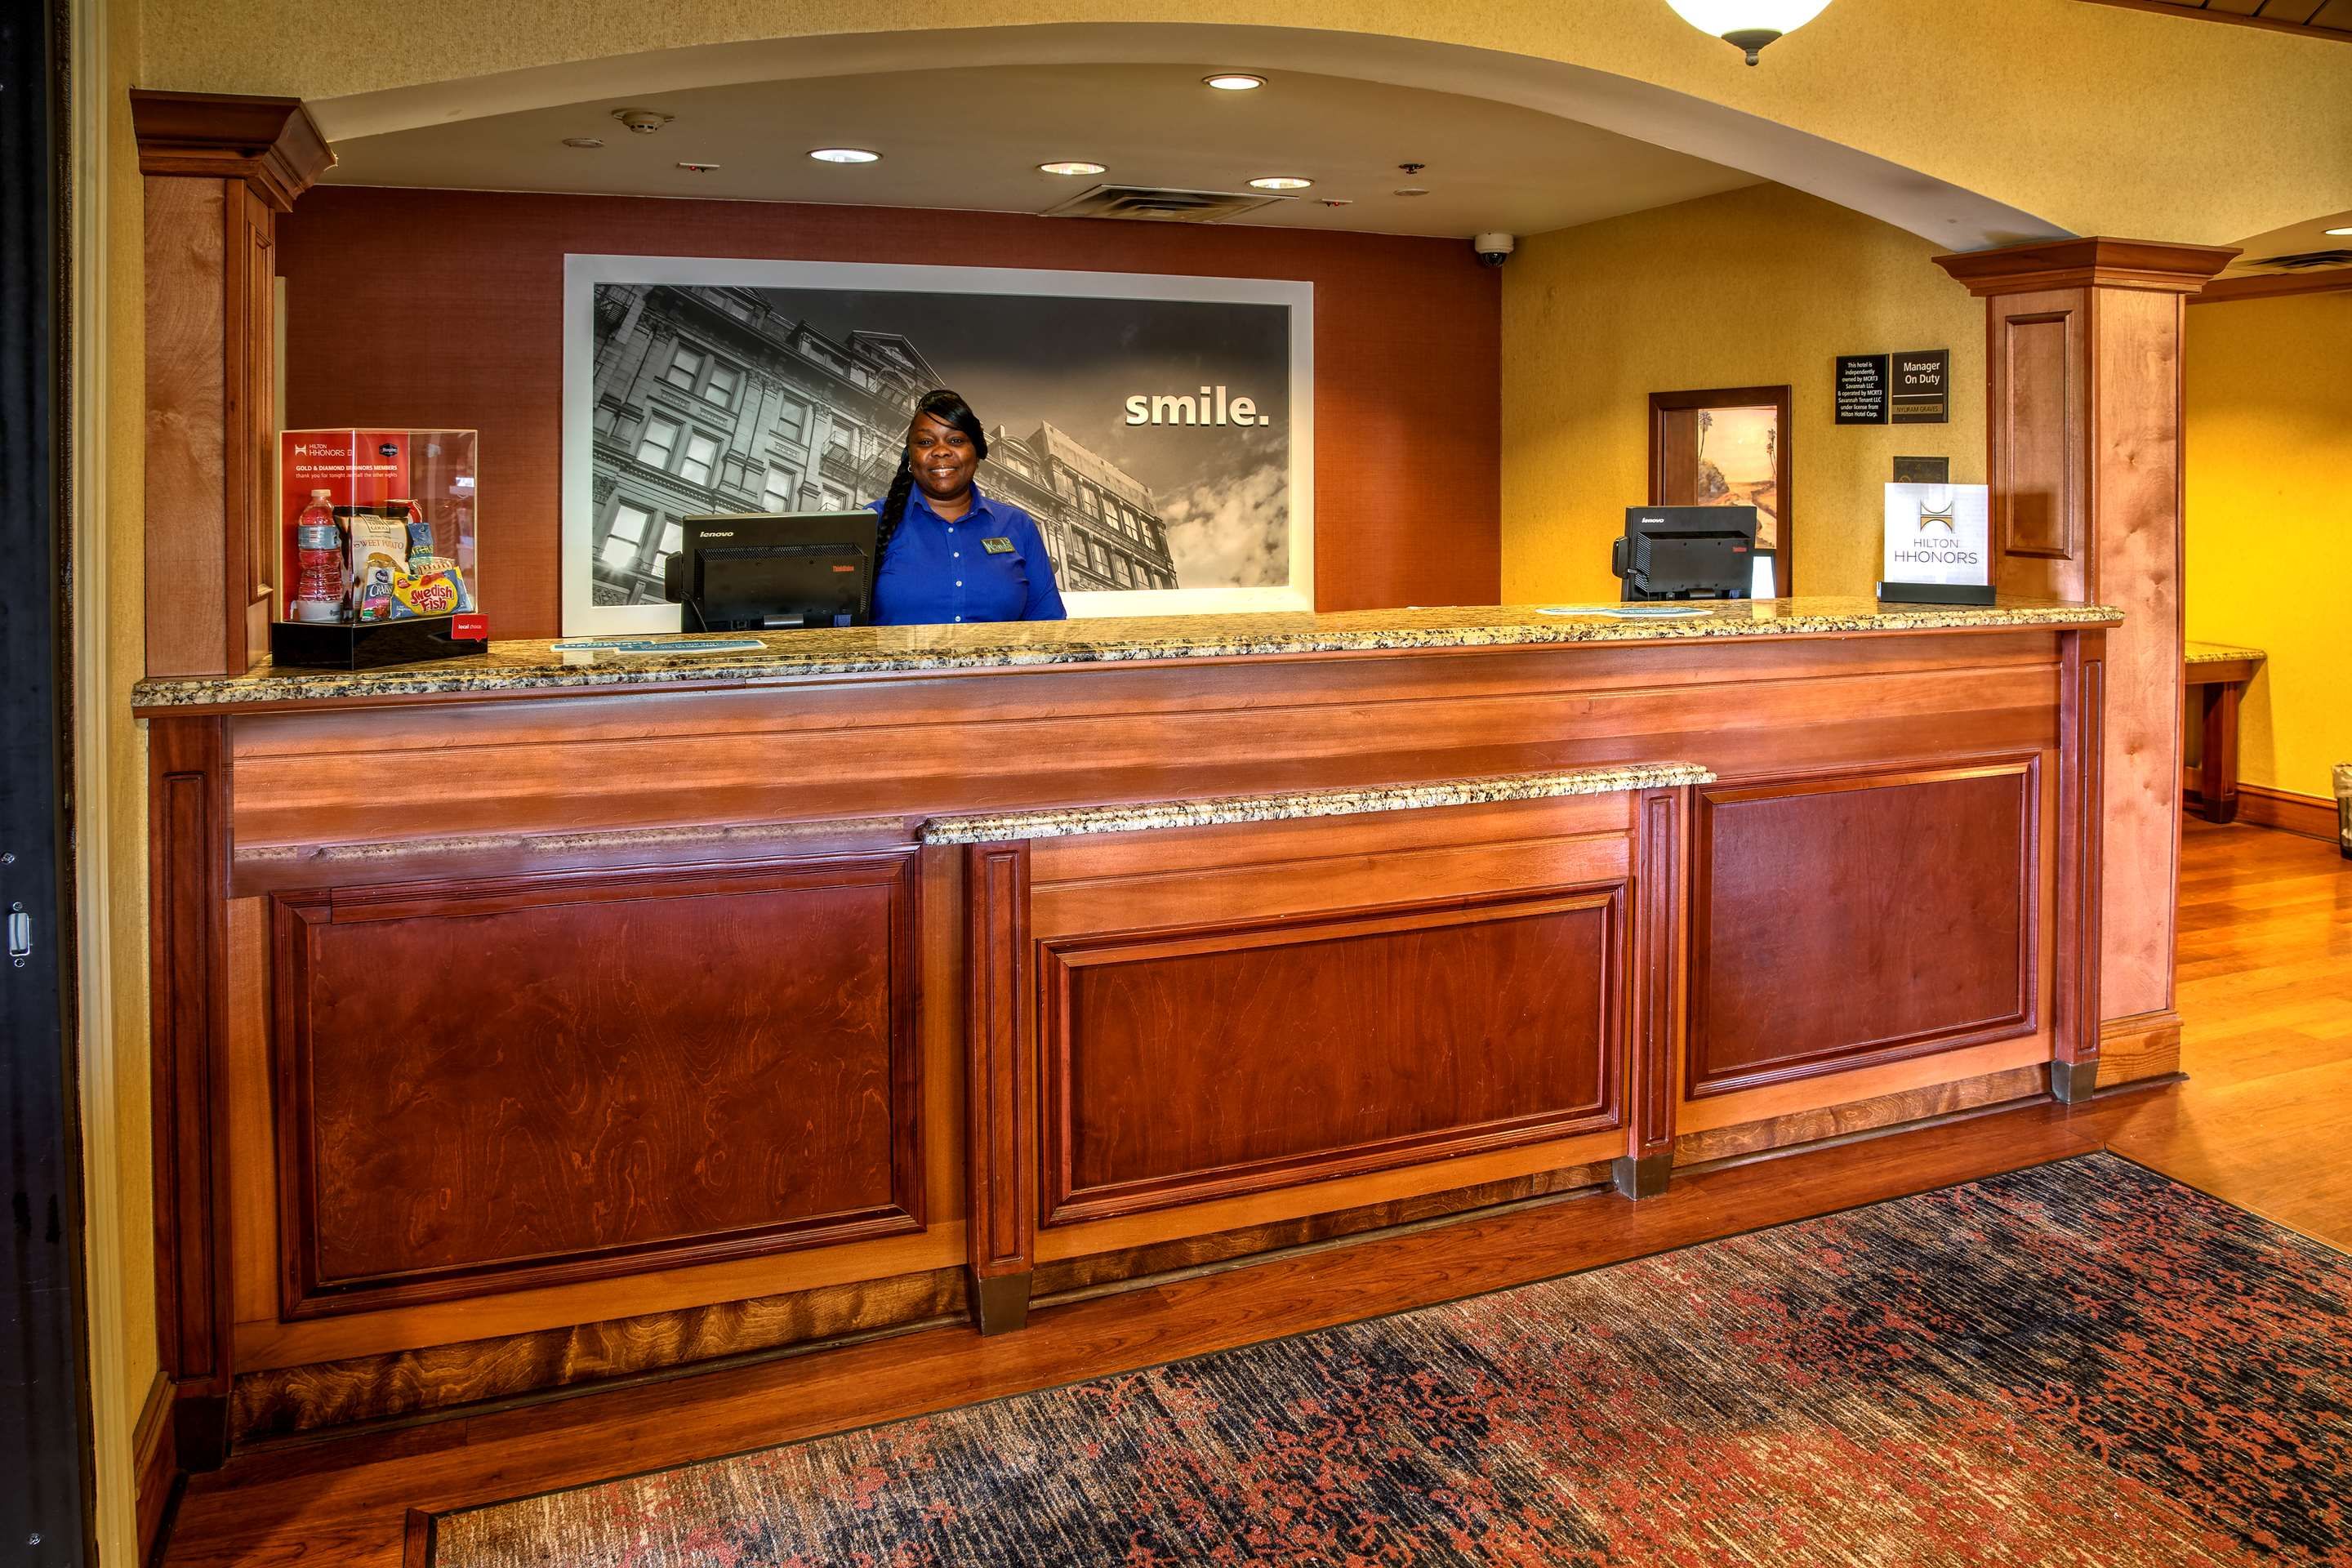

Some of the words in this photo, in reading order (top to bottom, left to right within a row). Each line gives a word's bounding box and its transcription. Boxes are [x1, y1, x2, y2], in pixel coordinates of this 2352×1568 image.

[1904, 362, 1940, 373] Manager
[1904, 375, 1918, 385] On
[1919, 374, 1940, 385] Duty
[1125, 385, 1269, 426] smile.
[1913, 538, 1959, 548] HILTON
[1894, 550, 1978, 564] HHONORS
[410, 584, 453, 605] Swedish
[420, 596, 448, 612] Fish
